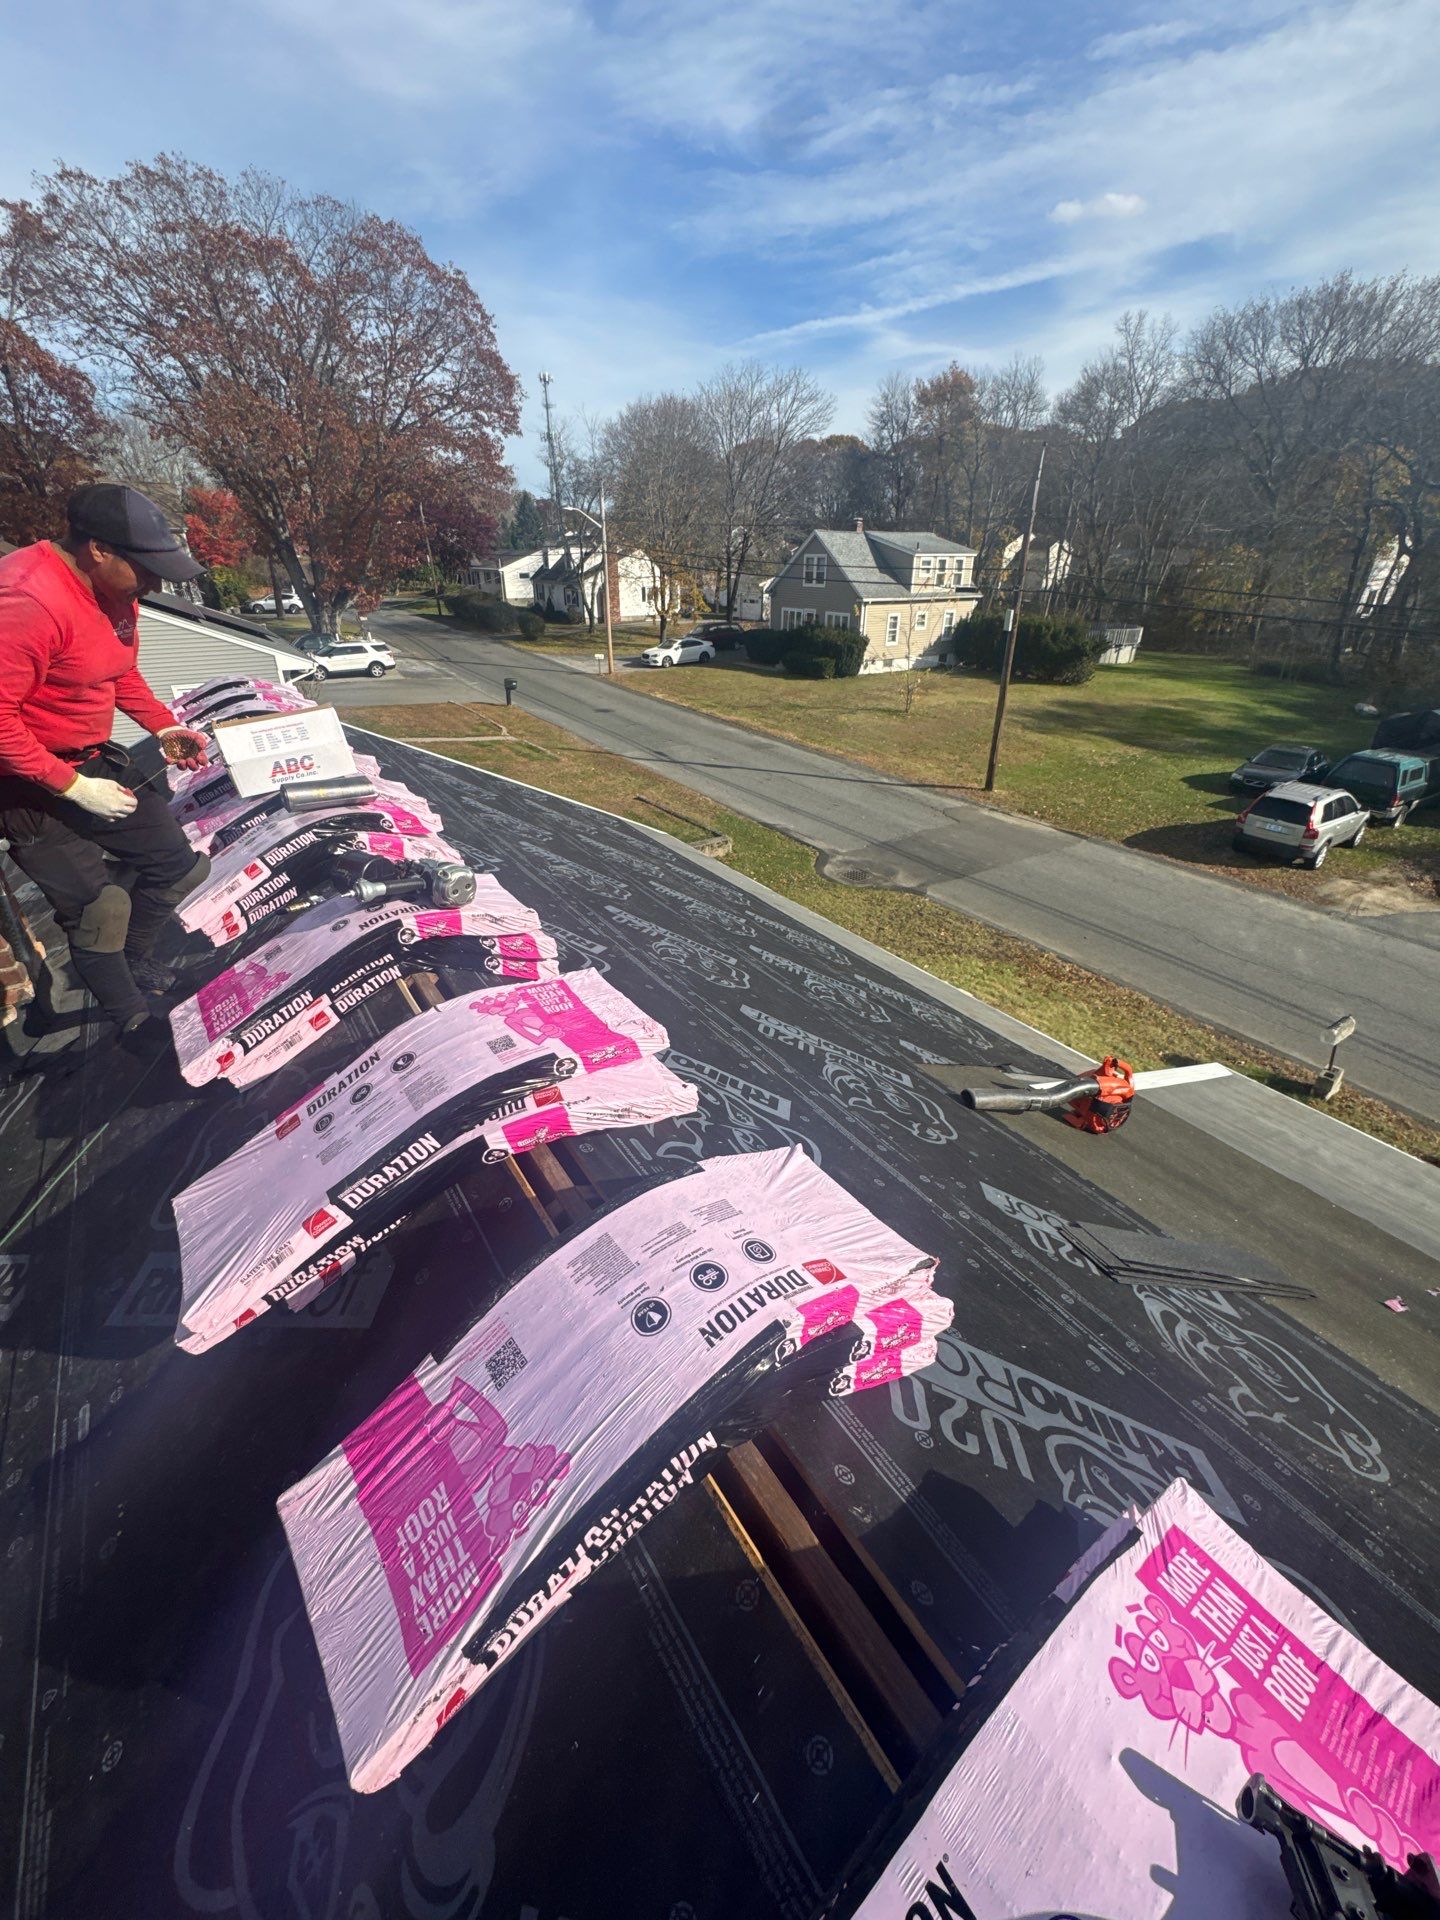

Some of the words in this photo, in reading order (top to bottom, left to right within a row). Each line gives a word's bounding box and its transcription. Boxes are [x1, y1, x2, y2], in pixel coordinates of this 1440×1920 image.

[269, 754, 315, 778] ABC
[271, 775, 295, 784] Supply
[224, 812, 268, 843] DURATION
[265, 830, 319, 867] DURATION
[239, 872, 291, 911] DURATION
[248, 886, 299, 925] DURATION
[242, 989, 315, 1049] DURATION
[335, 966, 402, 1014] DURATION
[757, 1022, 817, 1056] U20
[305, 1050, 381, 1117] DURATION
[656, 1047, 781, 1112] Rhino
[342, 1132, 442, 1210] DURATION
[268, 1234, 366, 1301] DURATION
[698, 1268, 809, 1349] DURATION
[889, 1375, 1036, 1483] U20
[930, 1337, 1217, 1499] RhinoRo
[396, 1480, 451, 1558] ROOF
[419, 1508, 458, 1566] JUST
[401, 1551, 417, 1580] A
[409, 1534, 471, 1616] THAN
[1156, 1546, 1212, 1608] MORE
[415, 1559, 481, 1646] MORE
[1190, 1576, 1248, 1643] THAN
[1250, 1614, 1280, 1645] A
[1230, 1623, 1273, 1680] JUST
[1263, 1641, 1320, 1723] ROOF
